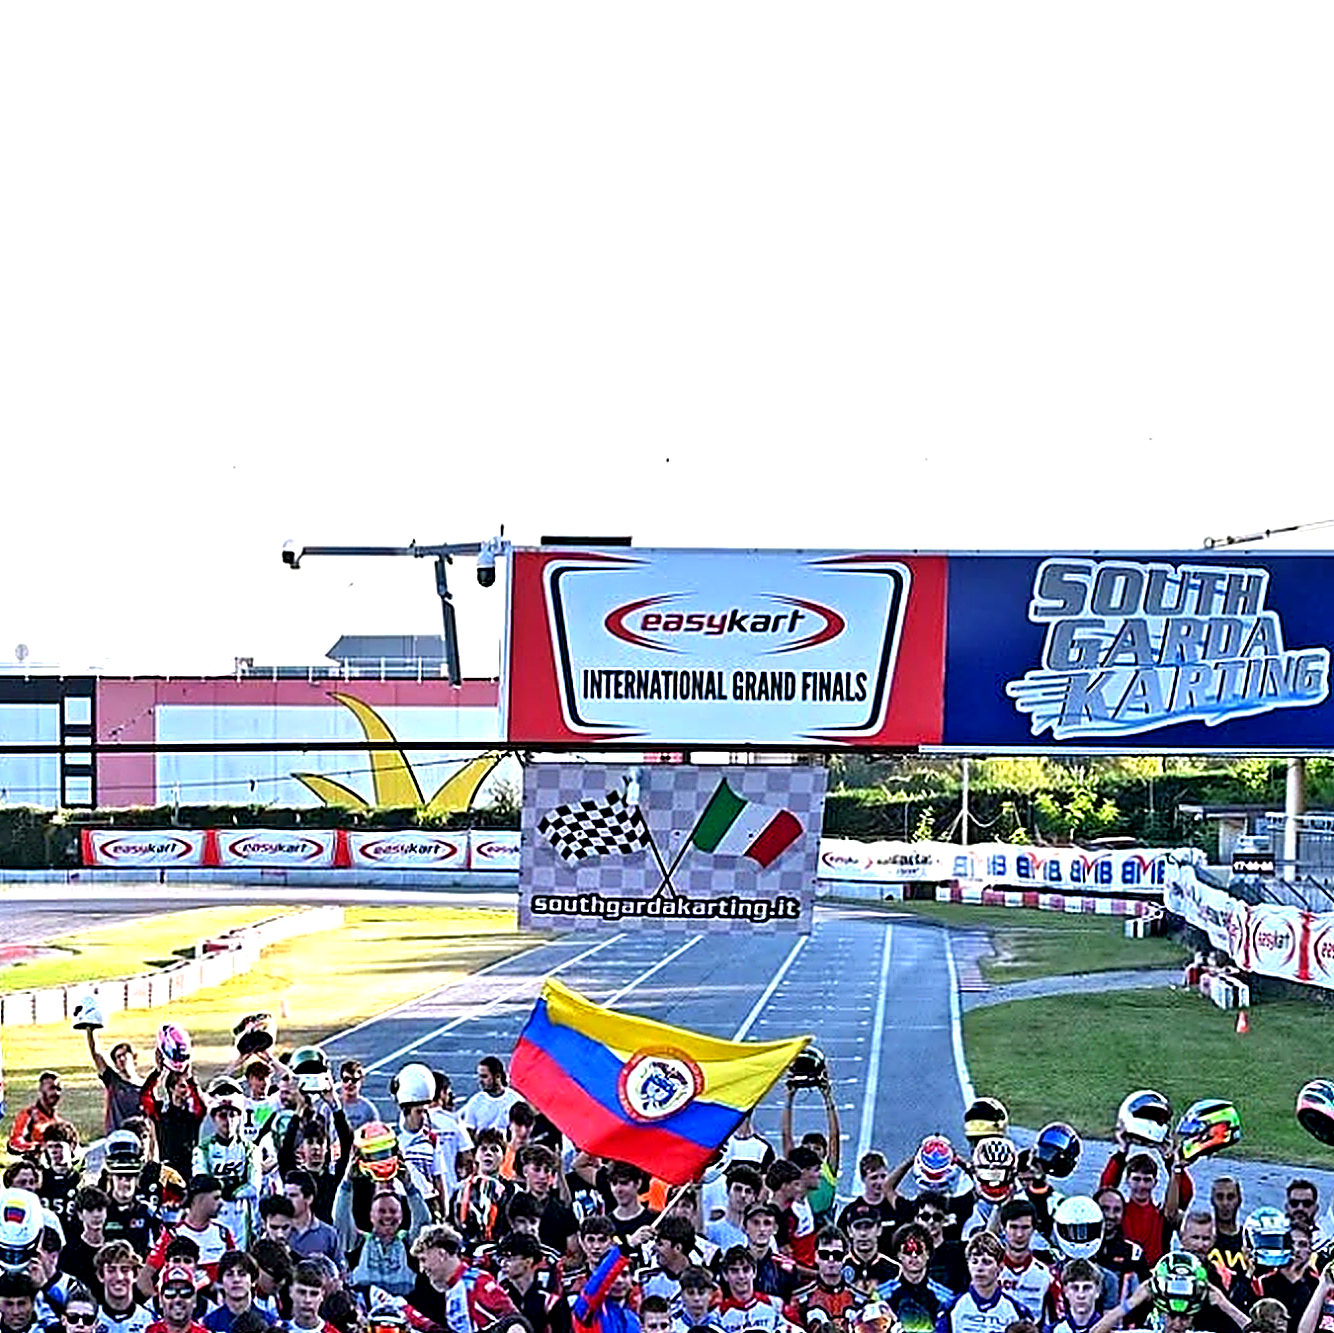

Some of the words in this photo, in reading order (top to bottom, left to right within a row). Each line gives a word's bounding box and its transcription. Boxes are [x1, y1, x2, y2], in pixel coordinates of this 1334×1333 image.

[1033, 564, 1263, 616] SOUTH
[640, 609, 805, 635] easykart
[1046, 618, 1280, 671] GARDA
[583, 669, 727, 700] INTERNATIONAL
[732, 670, 795, 701] GRAND
[802, 671, 867, 702] FINALS
[1058, 654, 1326, 727] KARTING
[113, 840, 177, 856] easykart
[242, 839, 308, 856] easykart
[372, 841, 441, 857] easykart
[486, 843, 520, 857] easyk
[1070, 855, 1113, 884] BMB
[534, 896, 798, 920] southgardakarting.it
